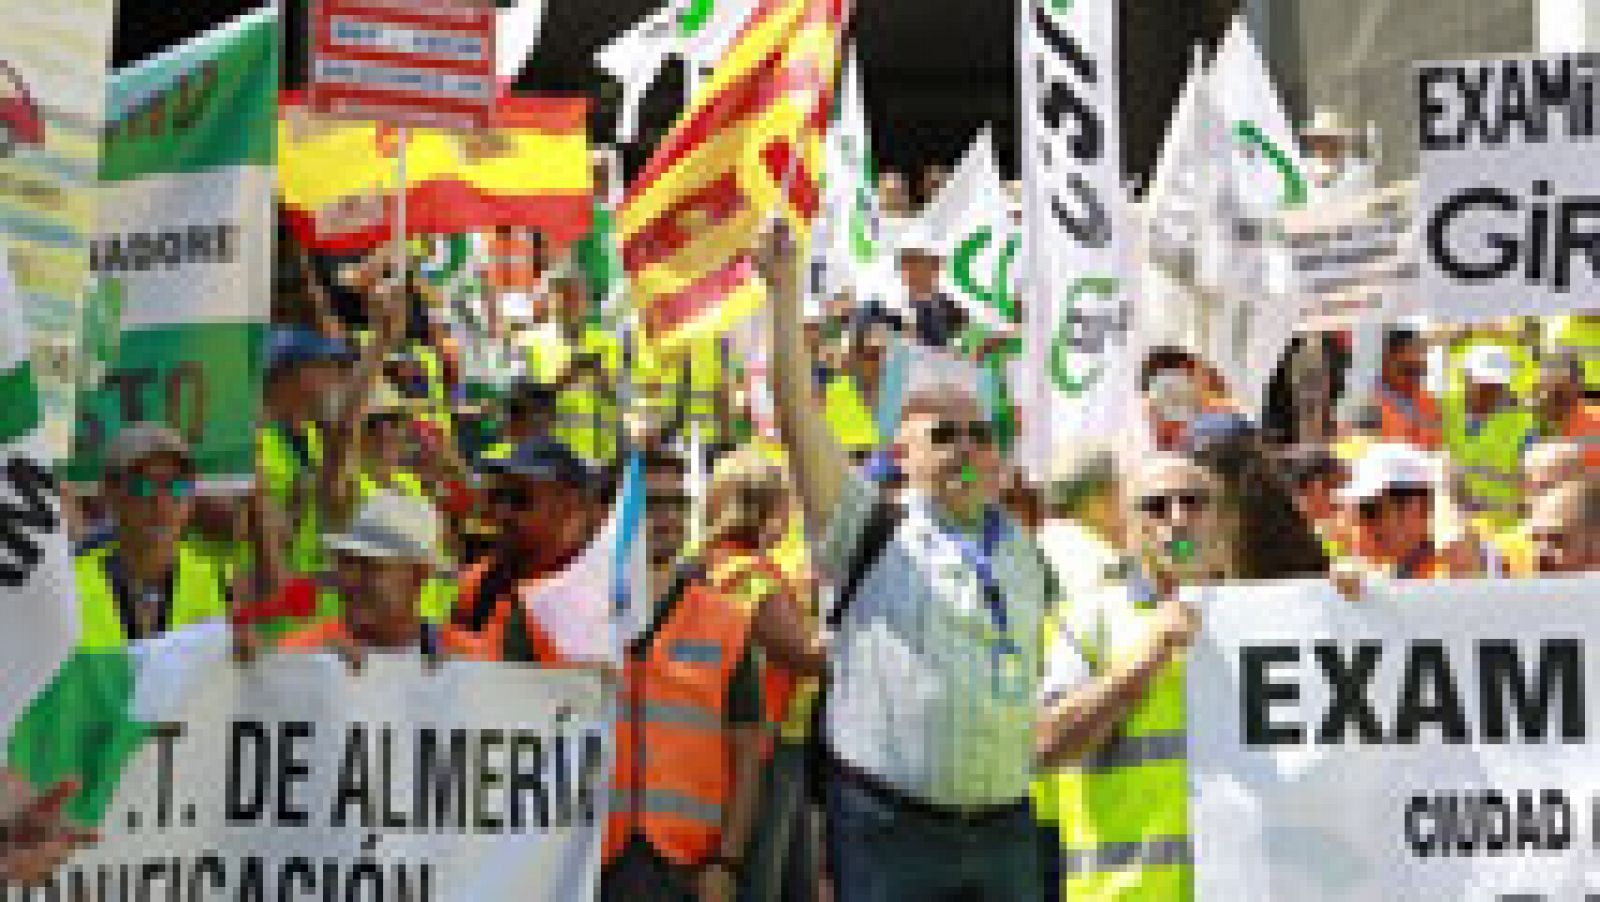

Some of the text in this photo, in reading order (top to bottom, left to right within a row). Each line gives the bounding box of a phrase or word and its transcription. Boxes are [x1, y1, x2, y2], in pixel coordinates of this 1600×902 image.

[1239, 638, 1587, 746] EXAM
[225, 720, 316, 827] DE
[1404, 789, 1572, 857] CIUDAD
